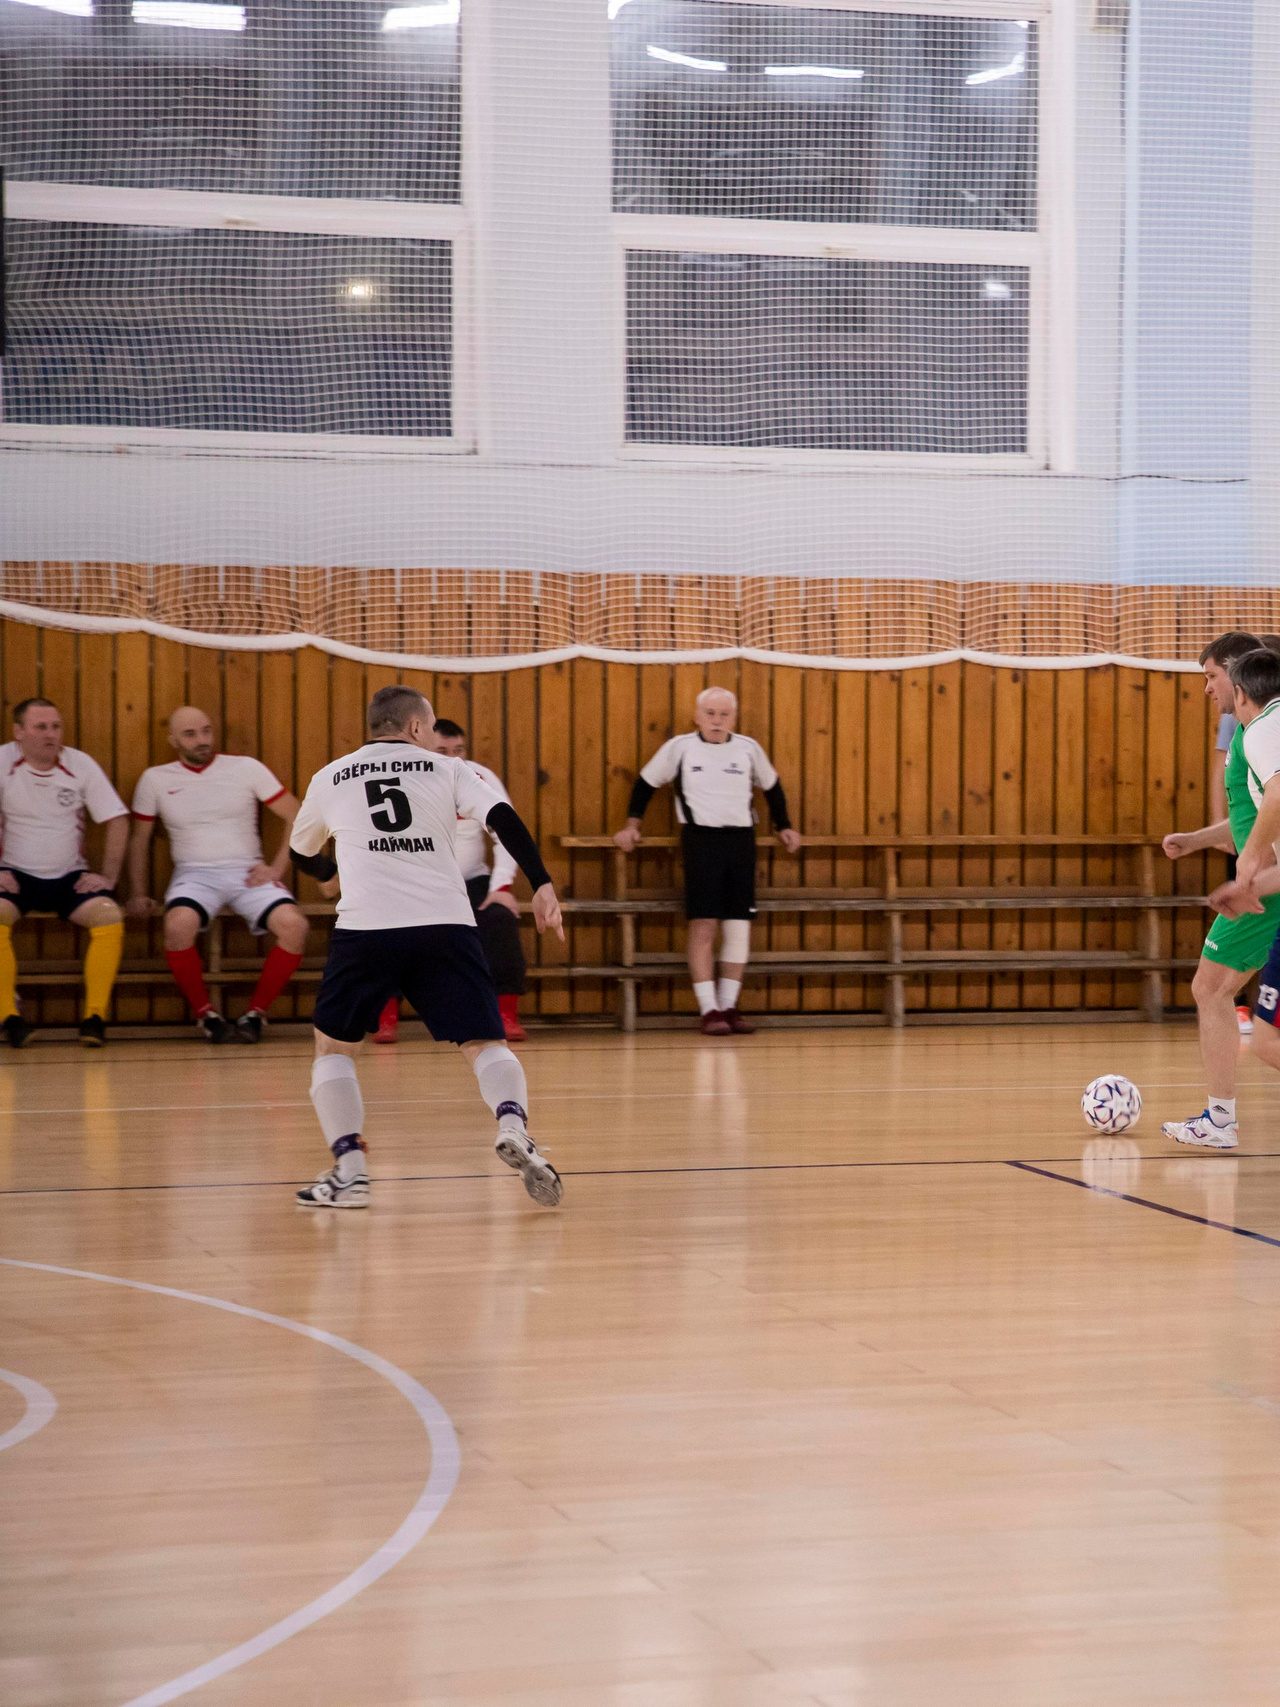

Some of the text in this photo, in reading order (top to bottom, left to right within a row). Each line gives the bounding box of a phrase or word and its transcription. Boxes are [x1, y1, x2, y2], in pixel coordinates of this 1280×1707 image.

[333, 760, 434, 786] ОЗЁРЫ СИТИ
[364, 776, 413, 832] 5
[368, 836, 435, 853] КАЙМАН
